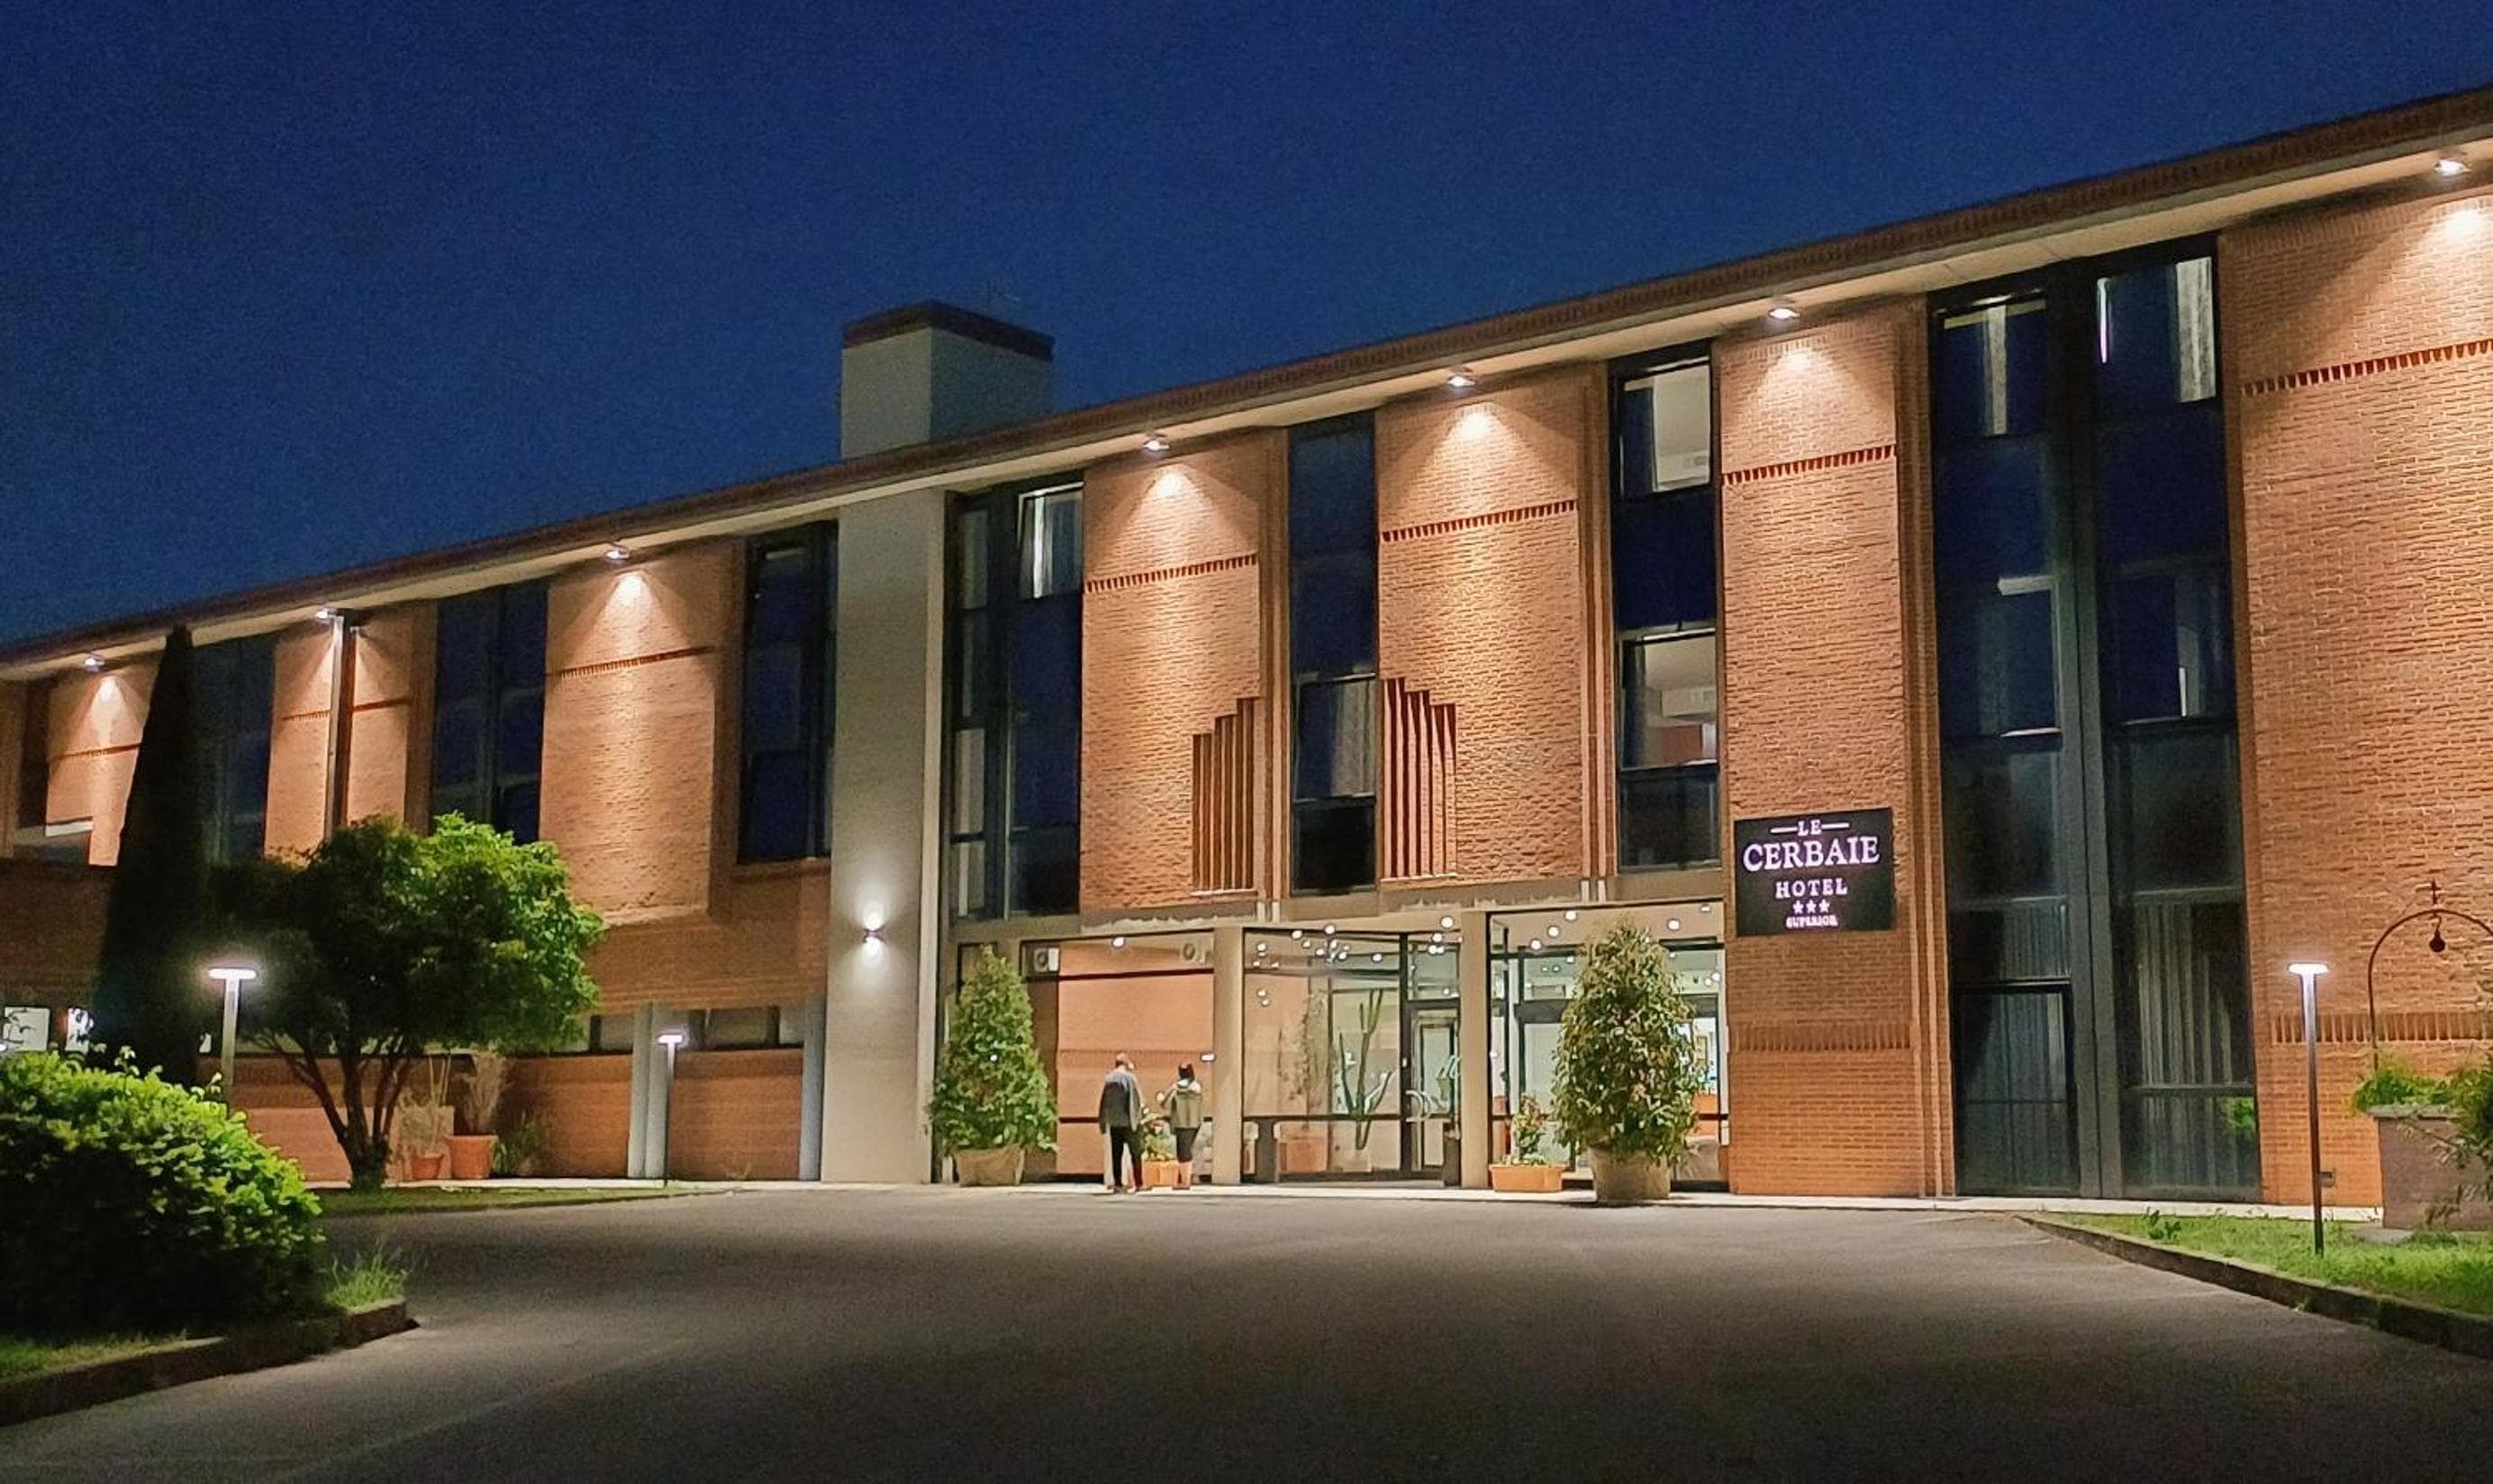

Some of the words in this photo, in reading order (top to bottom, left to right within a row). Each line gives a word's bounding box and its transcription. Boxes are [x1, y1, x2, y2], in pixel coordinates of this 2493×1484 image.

[1798, 819, 1822, 837] LE
[1743, 837, 1880, 872] CERBAIE
[1775, 878, 1848, 899] HOTEL
